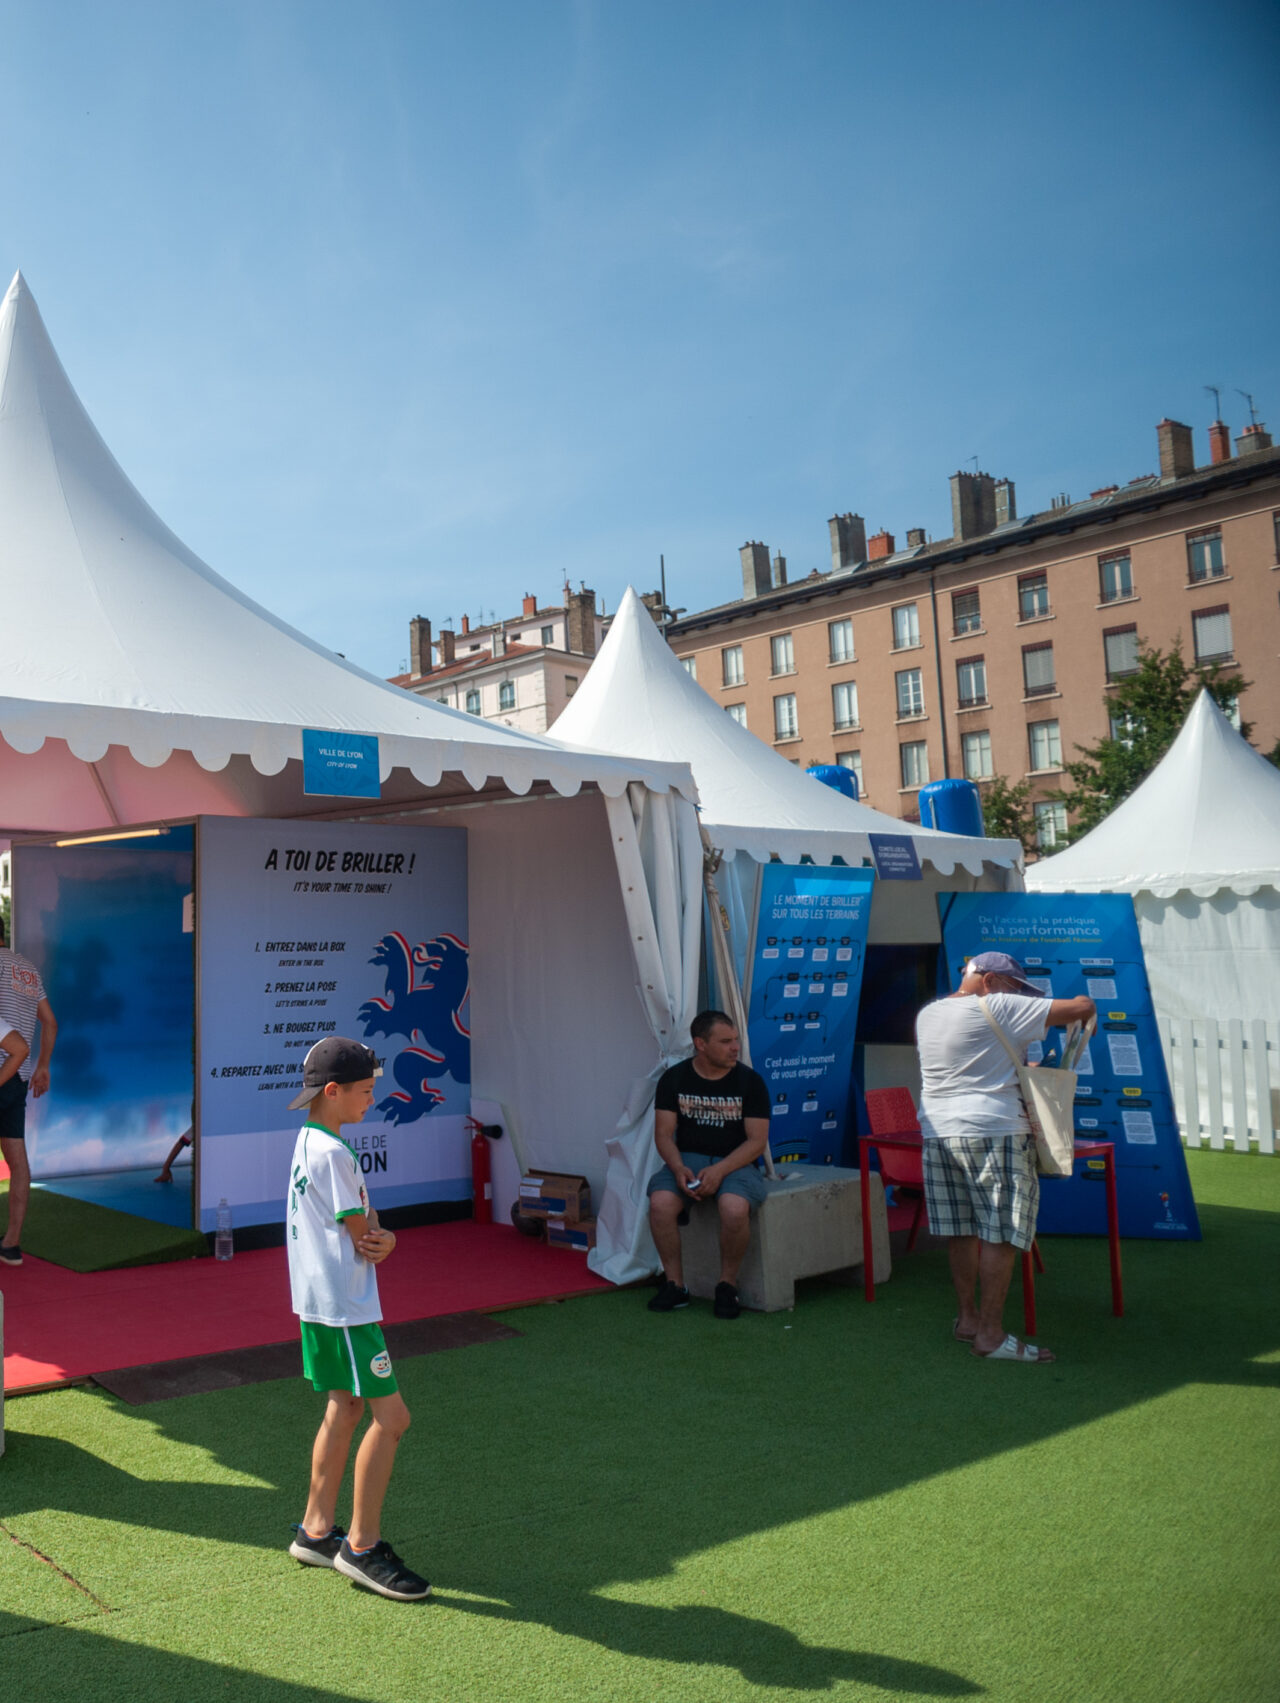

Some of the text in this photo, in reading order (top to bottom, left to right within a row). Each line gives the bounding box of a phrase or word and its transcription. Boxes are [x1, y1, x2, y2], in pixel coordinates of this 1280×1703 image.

[319, 748, 364, 760] VILLE DE LYON
[265, 849, 278, 870] A
[285, 850, 311, 871] TOI
[315, 850, 338, 872] DE
[341, 852, 405, 873] BRILLER
[293, 881, 308, 892] IT'S
[311, 882, 332, 893] YOUR
[334, 883, 352, 893] TIME
[354, 883, 364, 893] TO
[365, 883, 387, 894] SHINE
[774, 895, 783, 905] LE
[784, 895, 819, 906] MOMENT
[820, 896, 830, 906] DE
[772, 908, 860, 920] SUR TOUS LES TERRAINS
[993, 924, 1004, 935] la
[1009, 924, 1100, 936] performance
[265, 942, 295, 952] ENTREZ
[296, 942, 318, 952] DANS
[318, 942, 329, 952] LA
[330, 942, 346, 952] BOX
[264, 981, 338, 993] 2. PRENEZ LA POSE
[263, 1021, 337, 1034] 3. NE BOUGEZ PLUS
[765, 1053, 836, 1068] C'est aussi le moment
[210, 1067, 218, 1078] 4.
[221, 1065, 262, 1078] REPARTEZ
[263, 1064, 284, 1076] AVEC
[286, 1064, 299, 1074] UN
[771, 1070, 780, 1080] de
[781, 1070, 797, 1079] vous
[798, 1068, 823, 1079] engager
[372, 1135, 387, 1149] DE
[357, 1150, 388, 1174] ON
